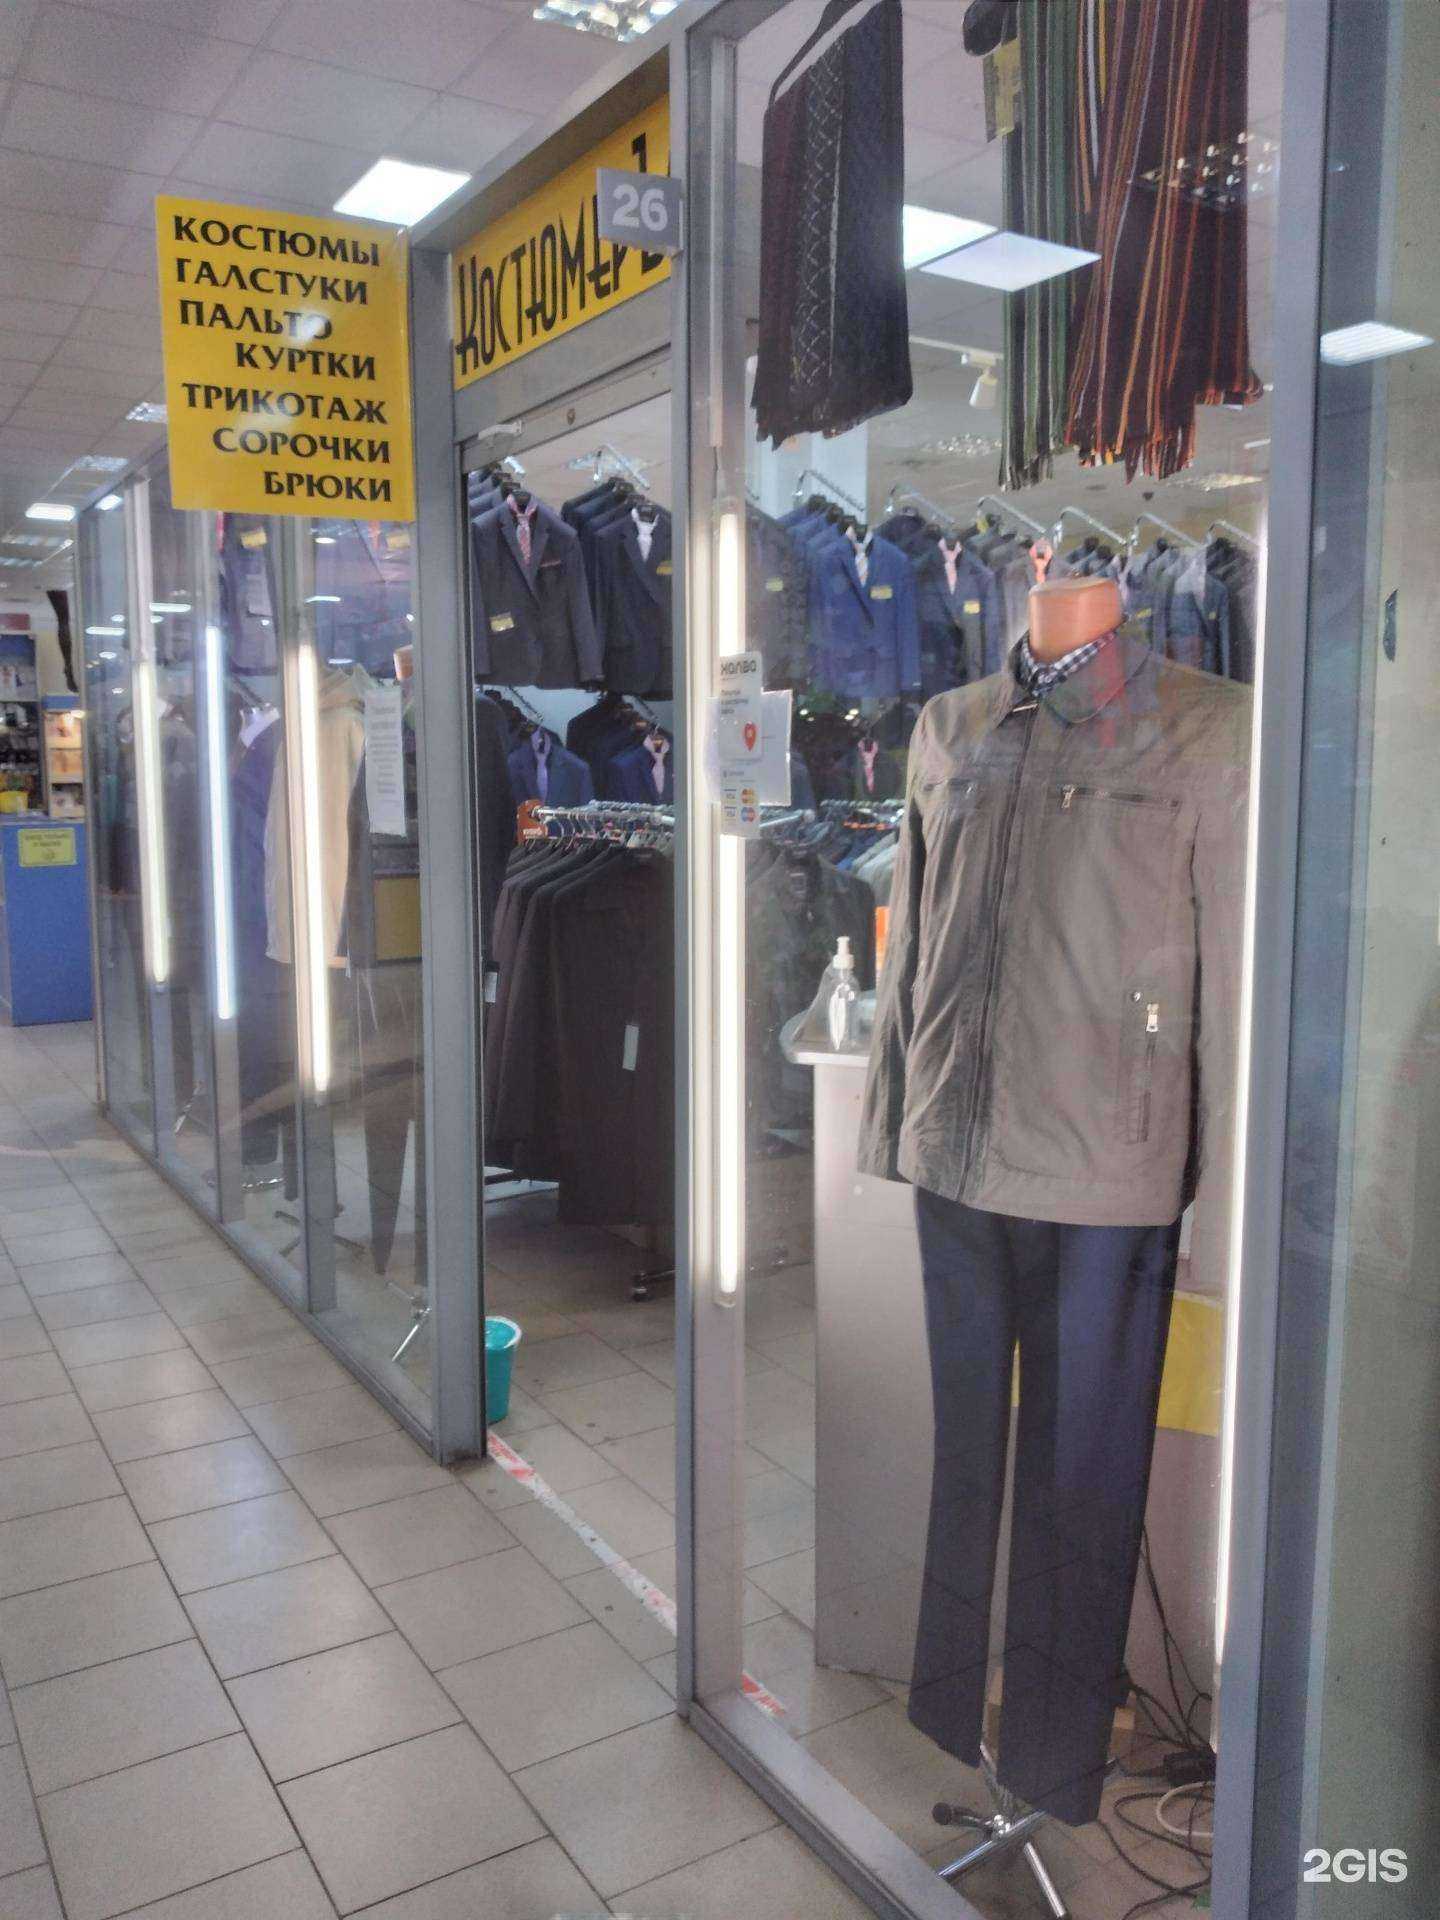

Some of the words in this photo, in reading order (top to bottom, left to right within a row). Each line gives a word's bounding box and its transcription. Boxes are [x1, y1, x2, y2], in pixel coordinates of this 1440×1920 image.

[612, 183, 669, 232] 26
[174, 215, 380, 267] КОСТЮМЫ
[176, 257, 368, 305] ГАЛСТУКИ
[179, 299, 332, 340] ПАЛЬТО
[236, 342, 376, 380] КУРТКИ
[181, 383, 388, 424] ТРИКОТАЖ
[212, 427, 390, 464] СОРОЧКИ
[263, 471, 392, 502] БРЮКИ
